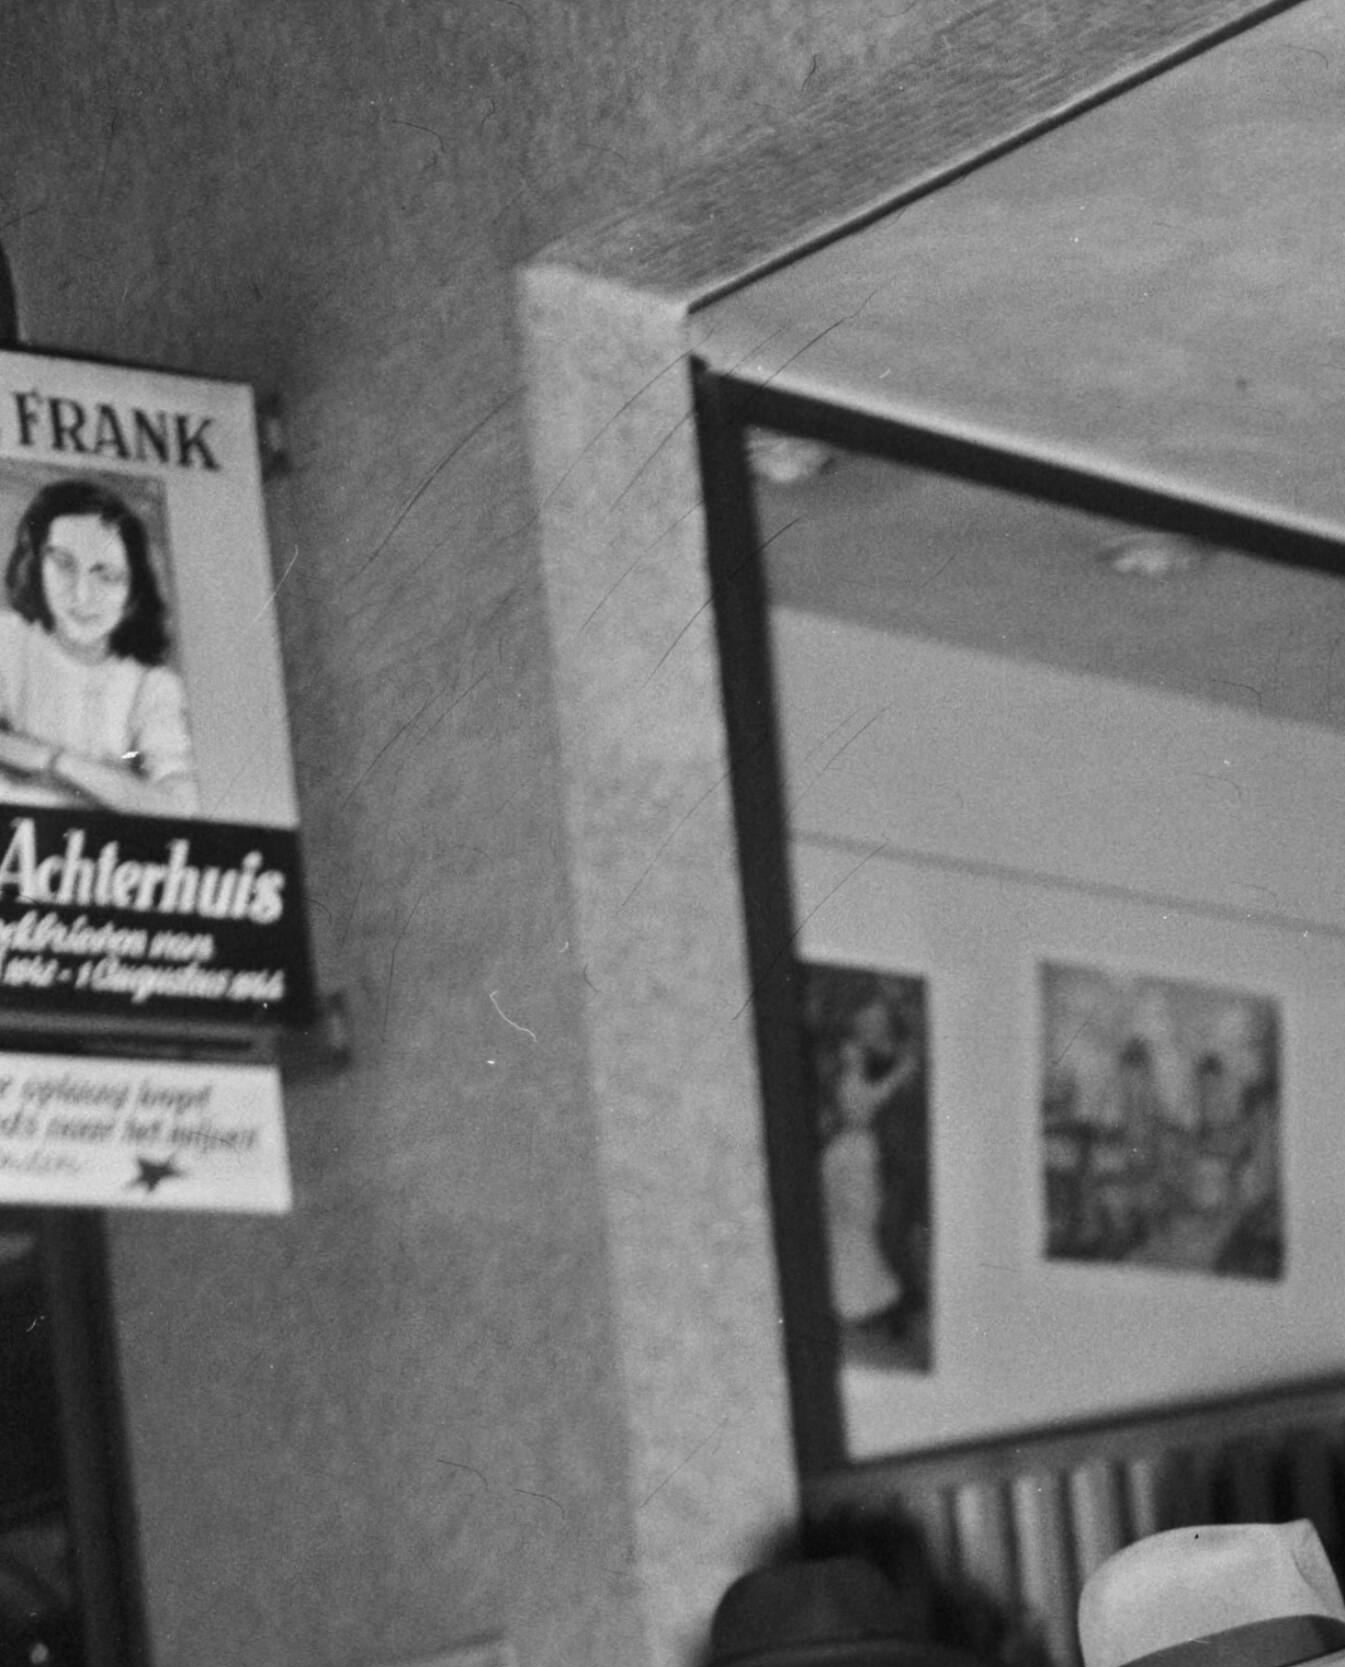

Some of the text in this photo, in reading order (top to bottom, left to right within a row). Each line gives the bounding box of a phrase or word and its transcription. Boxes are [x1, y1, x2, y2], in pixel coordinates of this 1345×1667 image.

[9, 387, 221, 473] FRANK
[0, 816, 287, 925] Achterhuis
[91, 953, 234, 1004] Augustus
